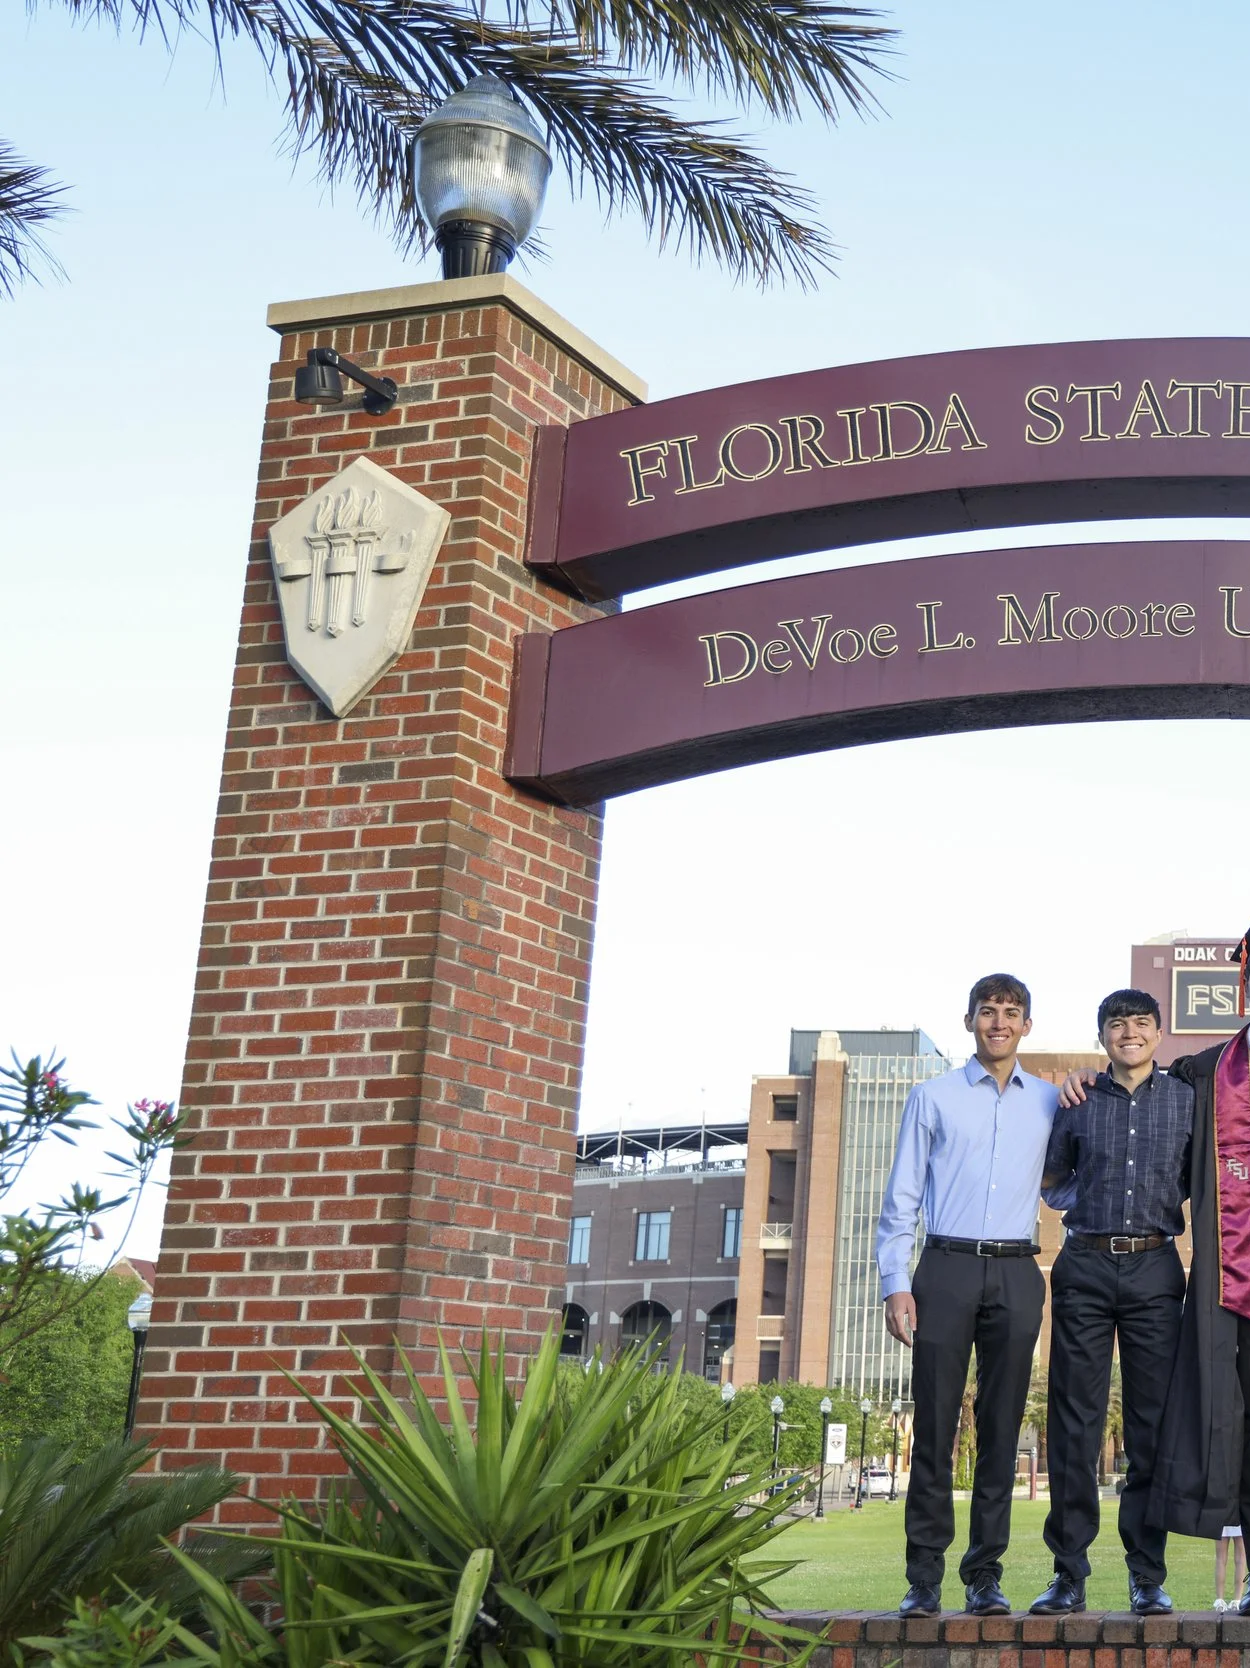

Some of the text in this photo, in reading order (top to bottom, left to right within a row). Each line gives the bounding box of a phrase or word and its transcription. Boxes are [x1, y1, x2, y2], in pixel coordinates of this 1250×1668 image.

[620, 393, 988, 506] FLORIDA
[699, 614, 899, 687] DeVoe
[917, 601, 976, 654] L.
[997, 591, 1196, 646] Moore
[1174, 947, 1217, 961] DOAK
[1226, 1158, 1249, 1180] FSU
